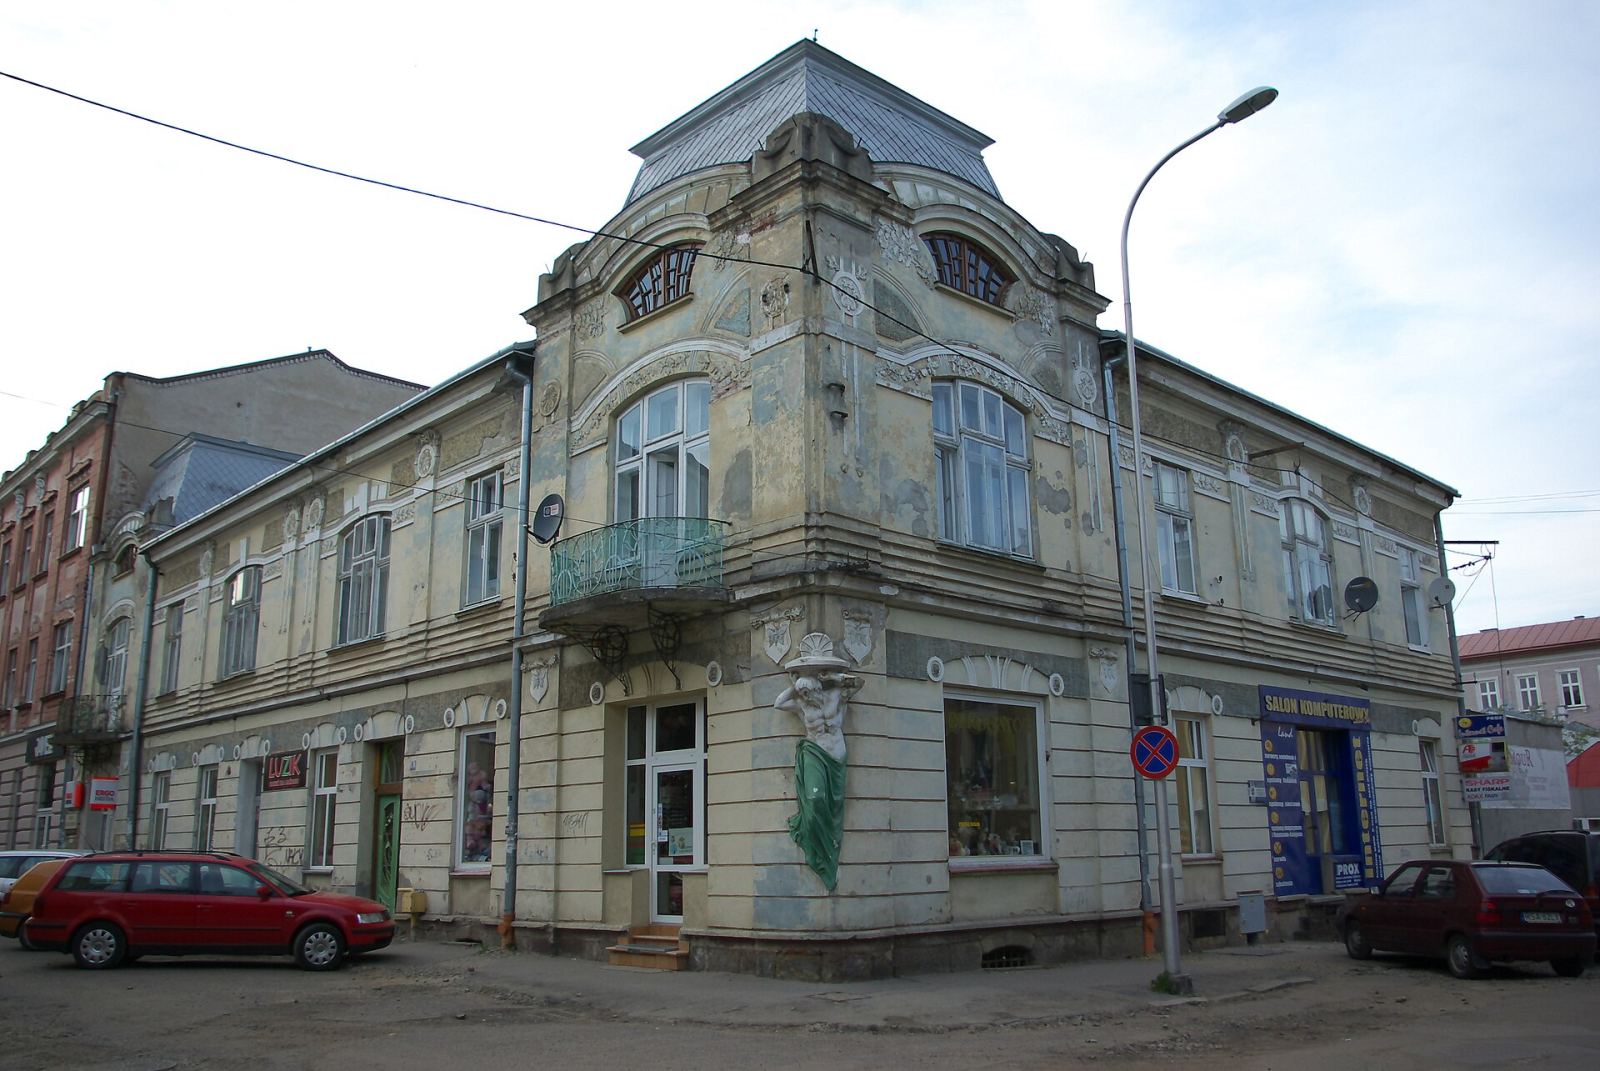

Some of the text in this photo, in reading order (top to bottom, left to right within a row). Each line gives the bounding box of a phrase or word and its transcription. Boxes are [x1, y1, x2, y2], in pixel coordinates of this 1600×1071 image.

[1265, 695, 1369, 721] SALON KOMPUTEROWY
[1465, 778, 1510, 787] SHARP
[1335, 863, 1360, 876] PROX
